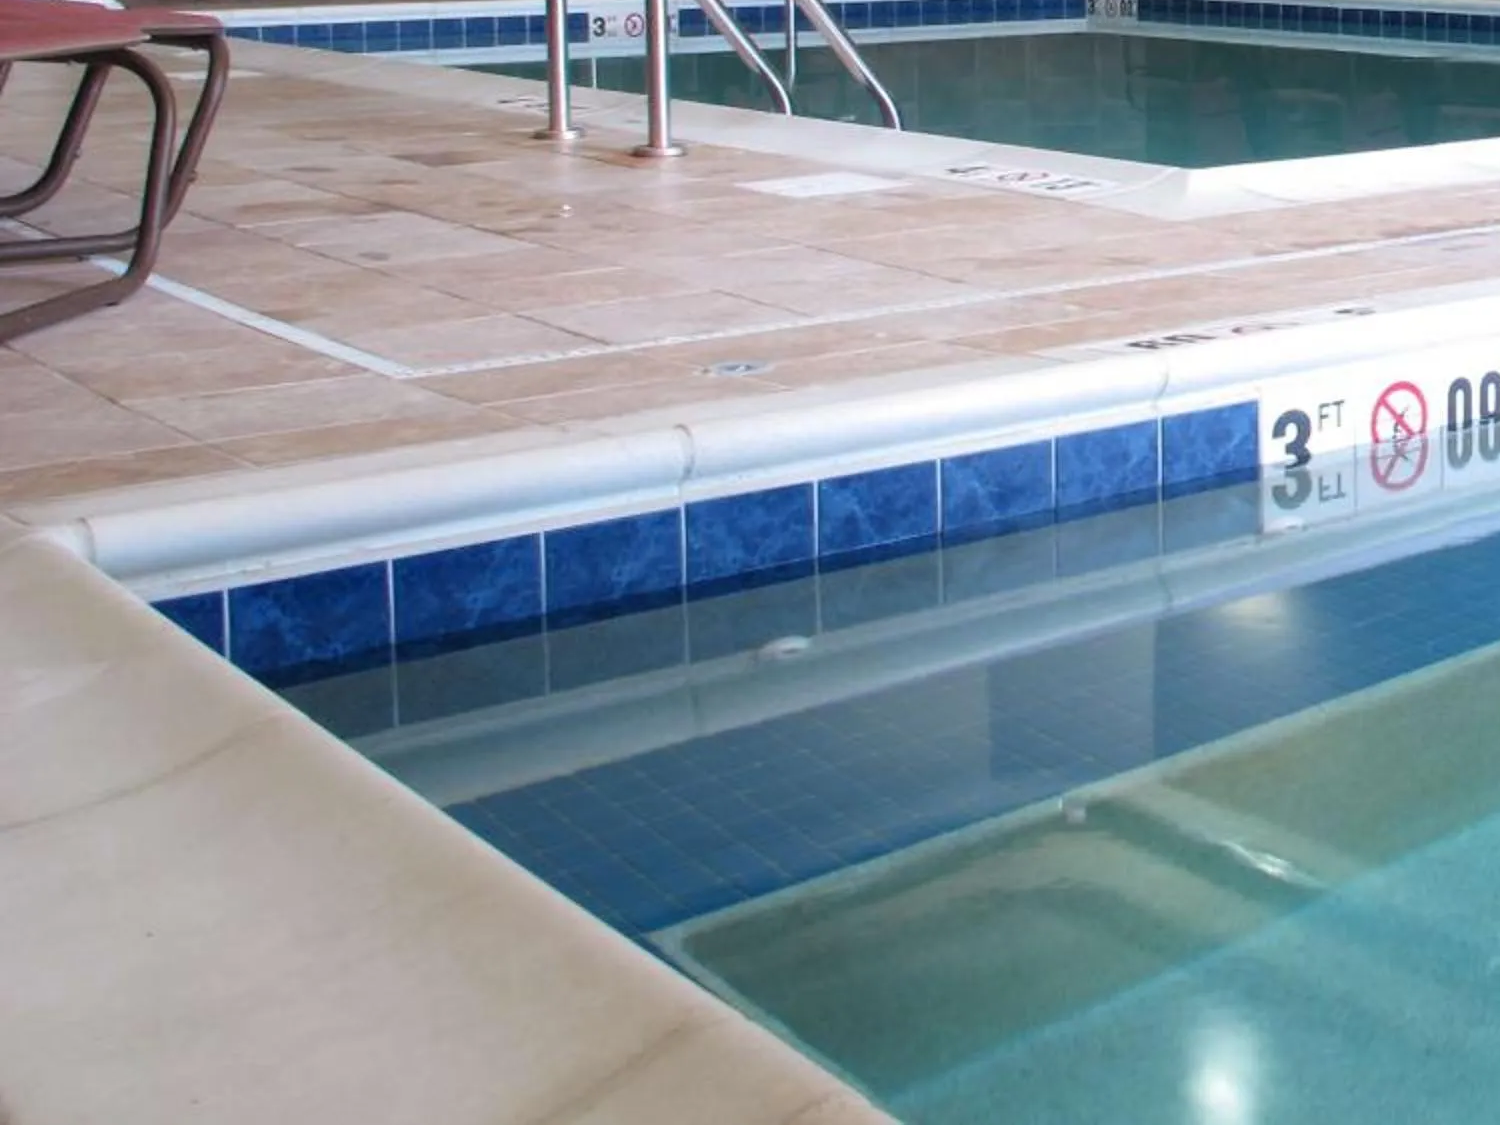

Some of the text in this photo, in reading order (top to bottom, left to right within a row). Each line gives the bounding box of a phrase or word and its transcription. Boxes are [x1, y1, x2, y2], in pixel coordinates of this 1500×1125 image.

[592, 17, 606, 37] 3
[1272, 408, 1312, 469] 3
[1318, 400, 1345, 431] FT
